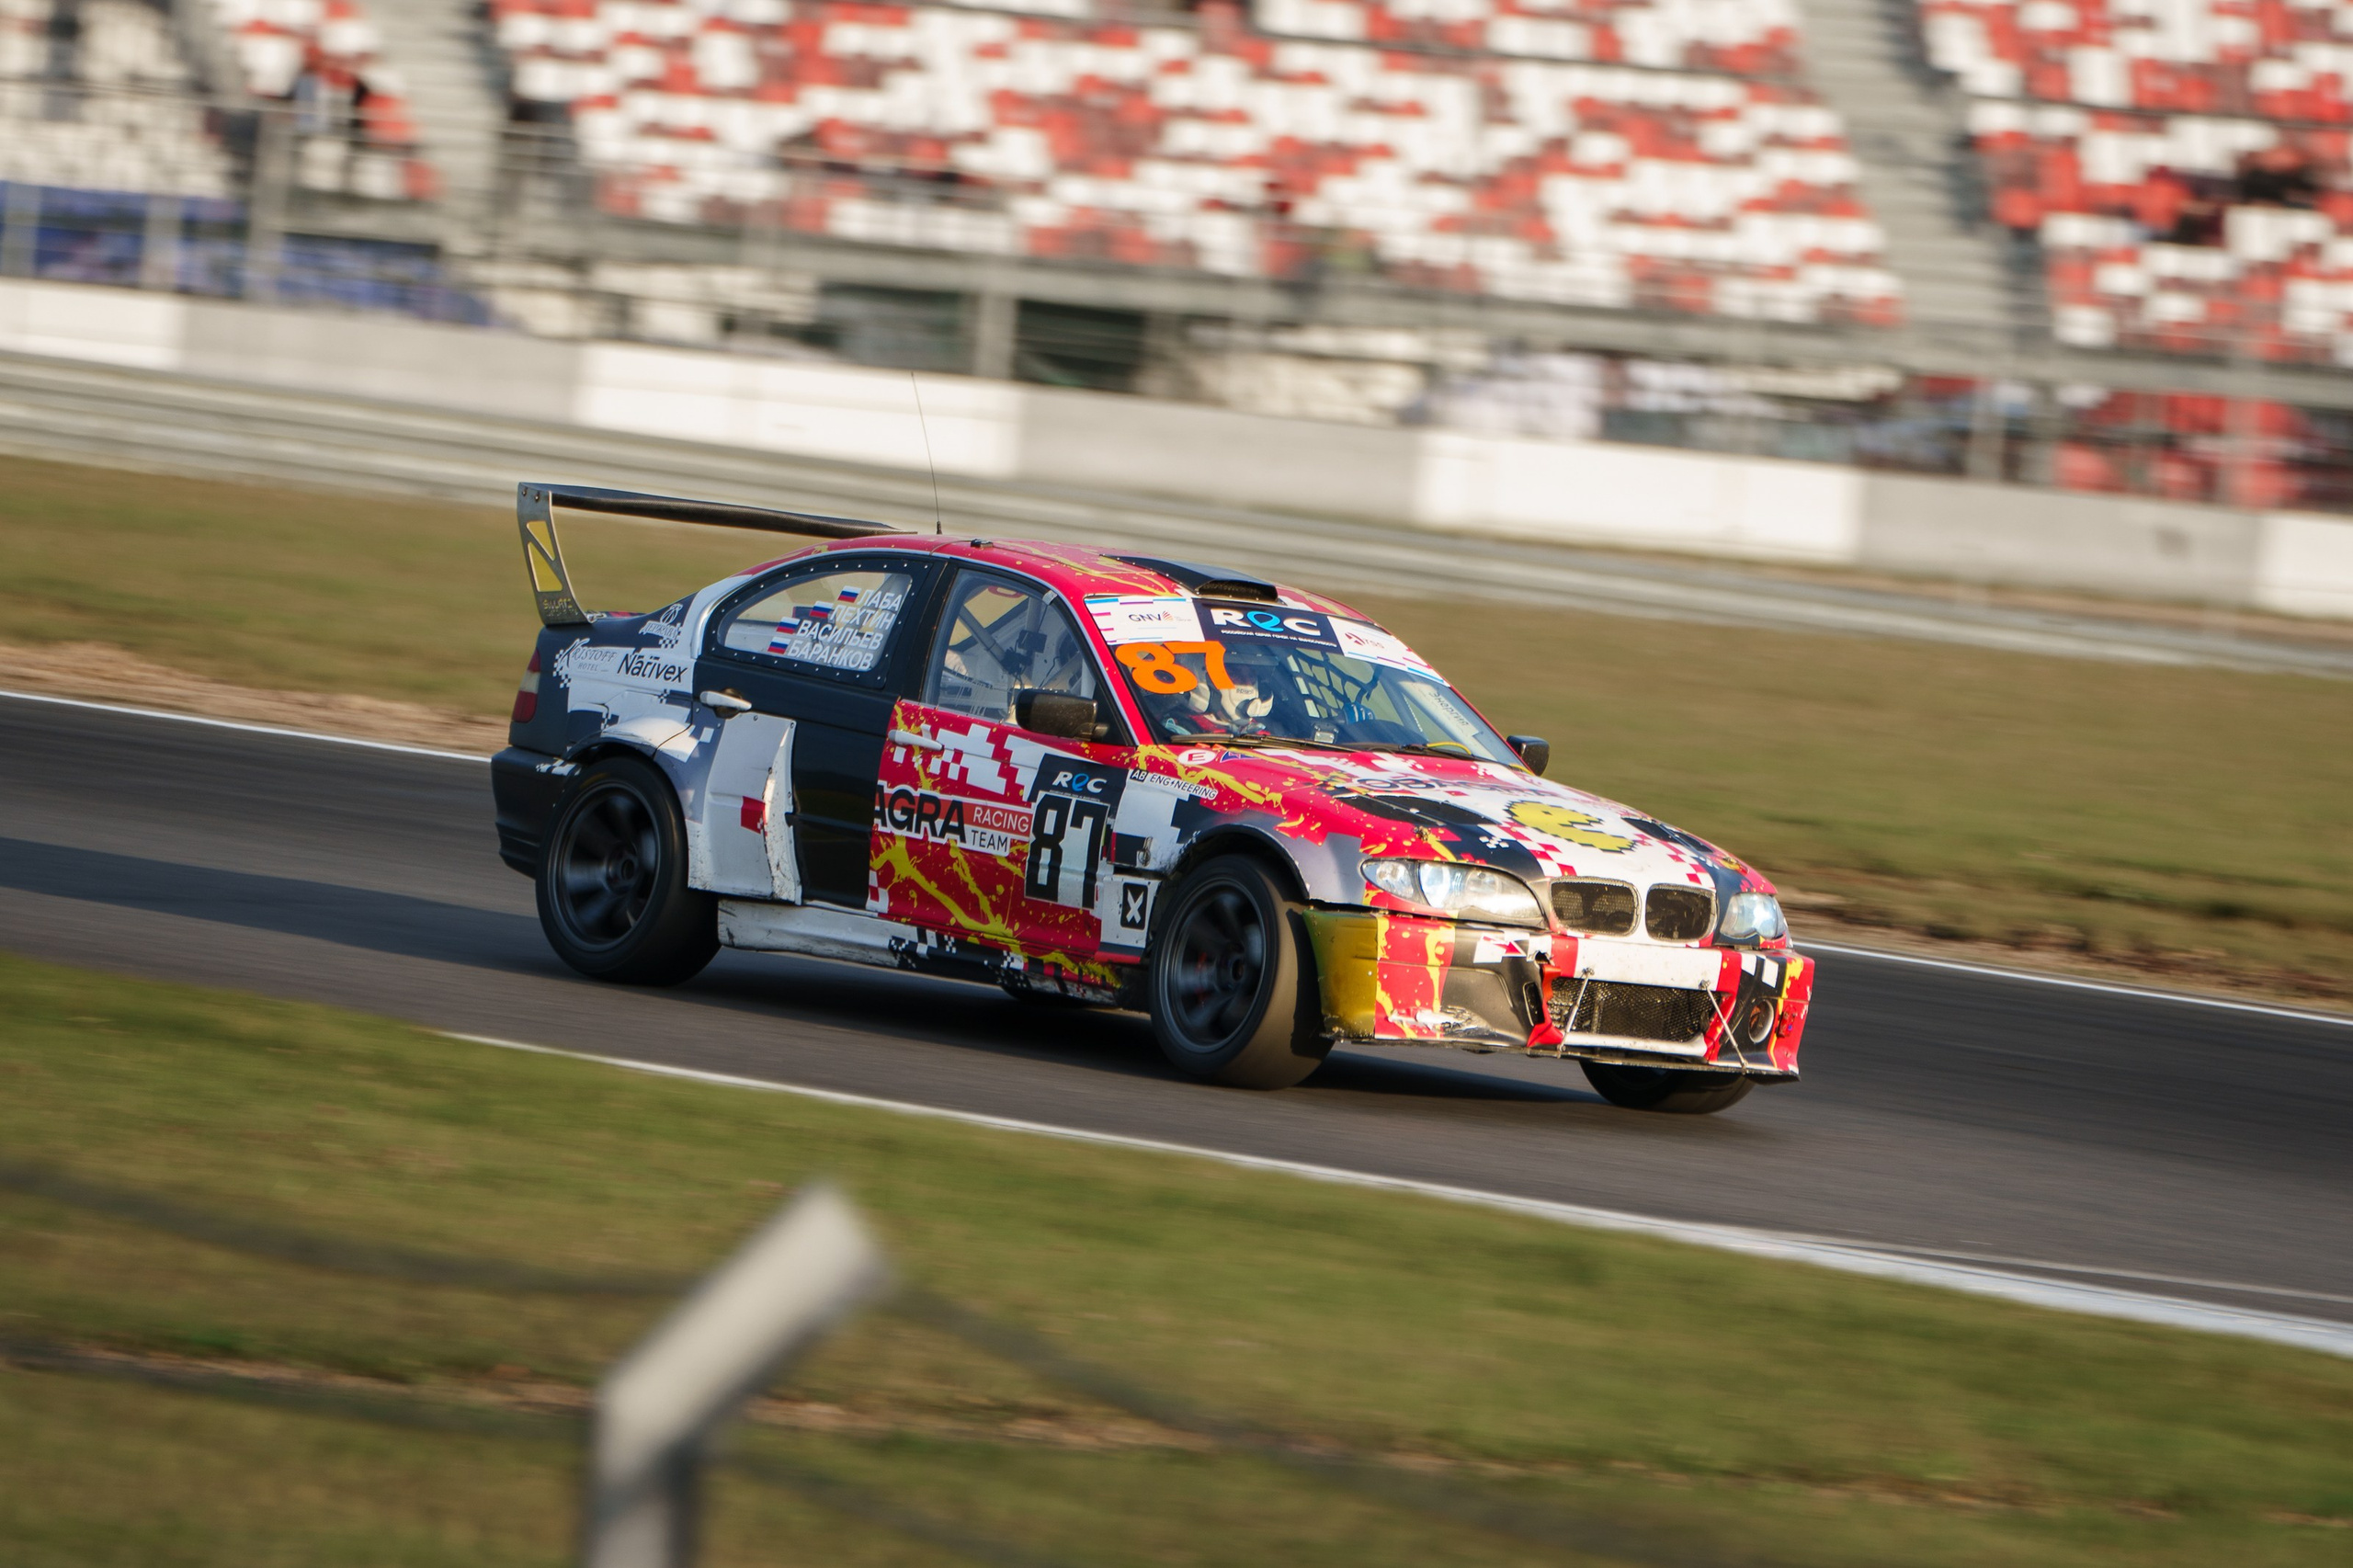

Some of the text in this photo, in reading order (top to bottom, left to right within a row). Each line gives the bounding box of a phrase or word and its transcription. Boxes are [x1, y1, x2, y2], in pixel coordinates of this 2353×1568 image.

[857, 589, 903, 611] ЛАБА
[830, 605, 895, 630] ПЕХТИН
[1129, 613, 1162, 622] GNV
[796, 620, 883, 650] ВАСИЛЬЕВ
[788, 640, 873, 670] БАРАНКОВ
[1115, 641, 1236, 695] 87
[1131, 772, 1146, 780] AB
[972, 806, 1030, 833] RACING
[971, 829, 1008, 853] TEAM
[1025, 790, 1110, 910] 87
